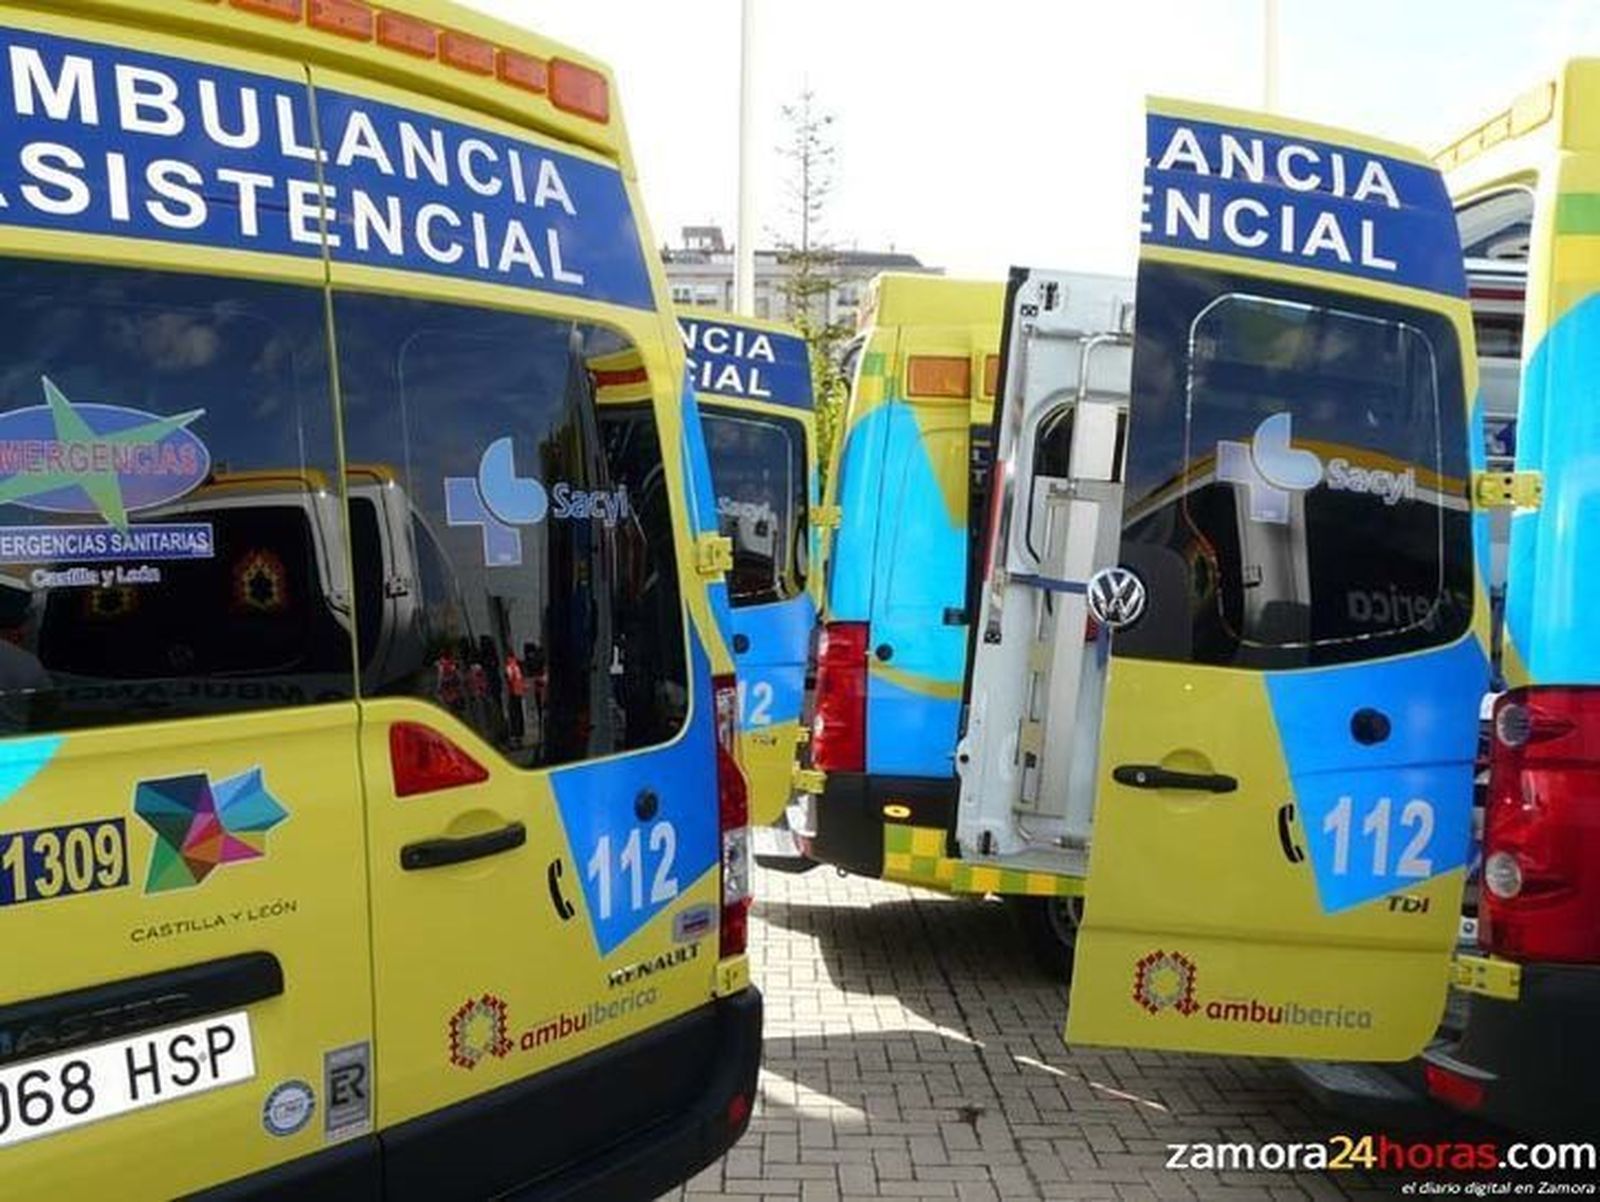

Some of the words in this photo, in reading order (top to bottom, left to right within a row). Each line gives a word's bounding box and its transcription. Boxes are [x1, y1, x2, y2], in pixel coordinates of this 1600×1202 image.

[8, 45, 578, 216] MBULANCIA
[1145, 126, 1400, 209] ANCIA
[0, 141, 584, 286] SISTENCIAL
[687, 358, 772, 396] IAL
[1, 535, 106, 556] ERGENCIAS
[111, 531, 209, 553] SANITARIAS
[31, 568, 100, 588] Castilla
[101, 569, 115, 588] y
[3, 823, 123, 901] 1309
[587, 821, 679, 920] 112
[1323, 796, 1435, 878] 112
[130, 914, 226, 943] CASTILLA
[231, 911, 243, 922] Y
[248, 899, 298, 921] LEÓN
[1387, 895, 1430, 914] TDI
[1206, 999, 1372, 1029] ambuiberica
[126, 1024, 235, 1101] HSP
